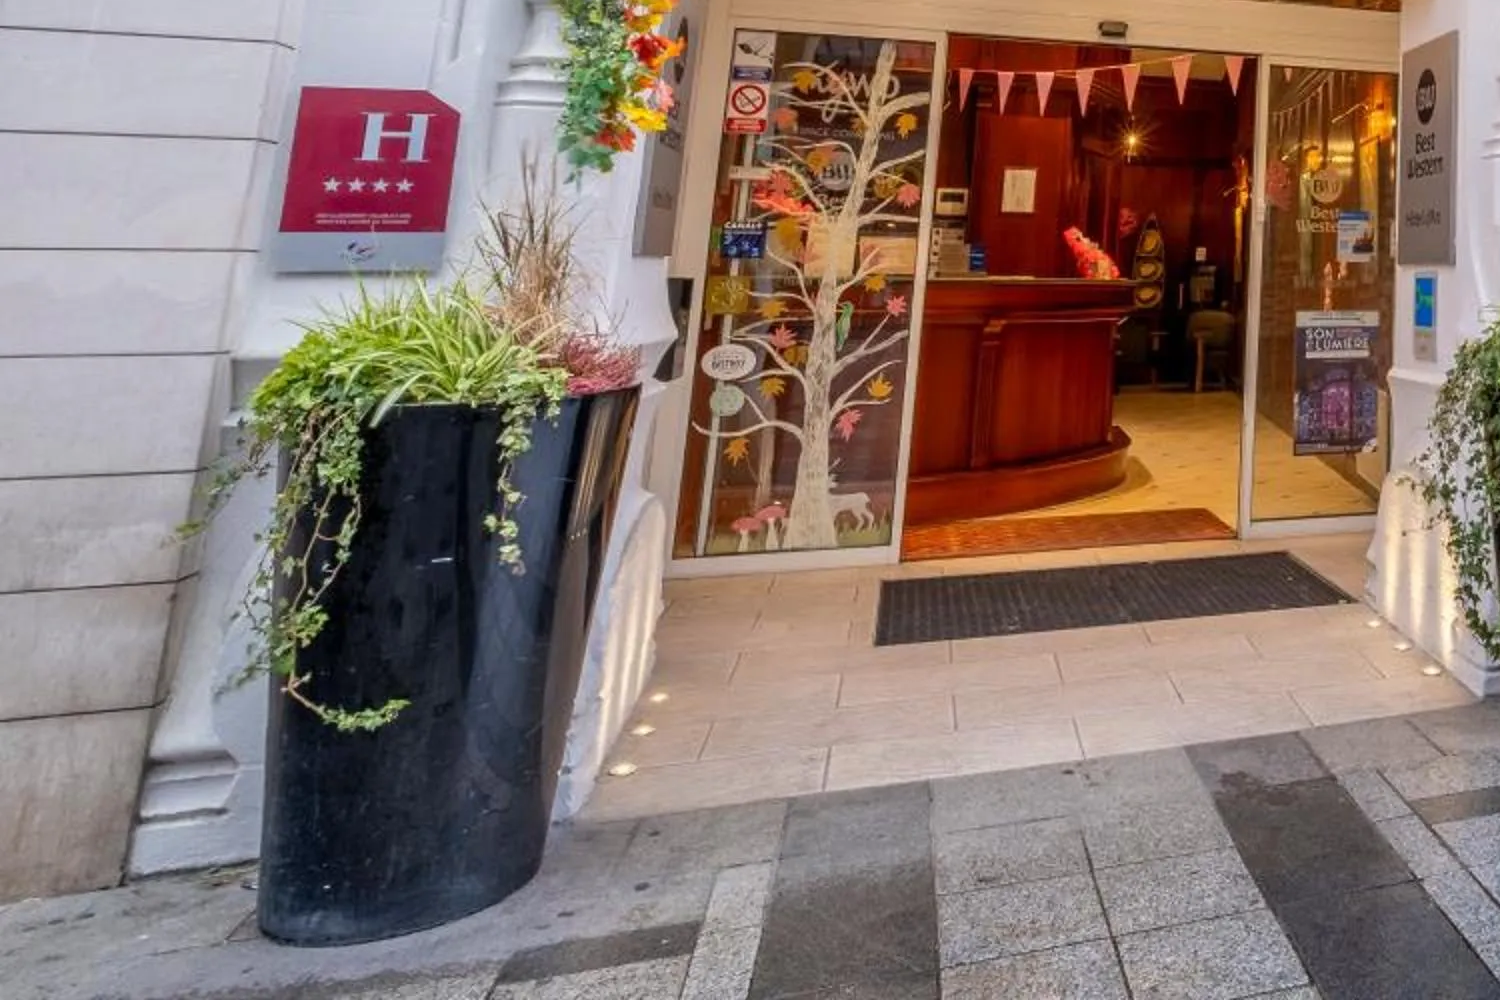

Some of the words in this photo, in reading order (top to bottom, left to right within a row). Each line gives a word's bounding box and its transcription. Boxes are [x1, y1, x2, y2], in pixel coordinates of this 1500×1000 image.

[352, 111, 438, 163] H
[1415, 131, 1436, 155] Best
[1305, 327, 1335, 340] SON
